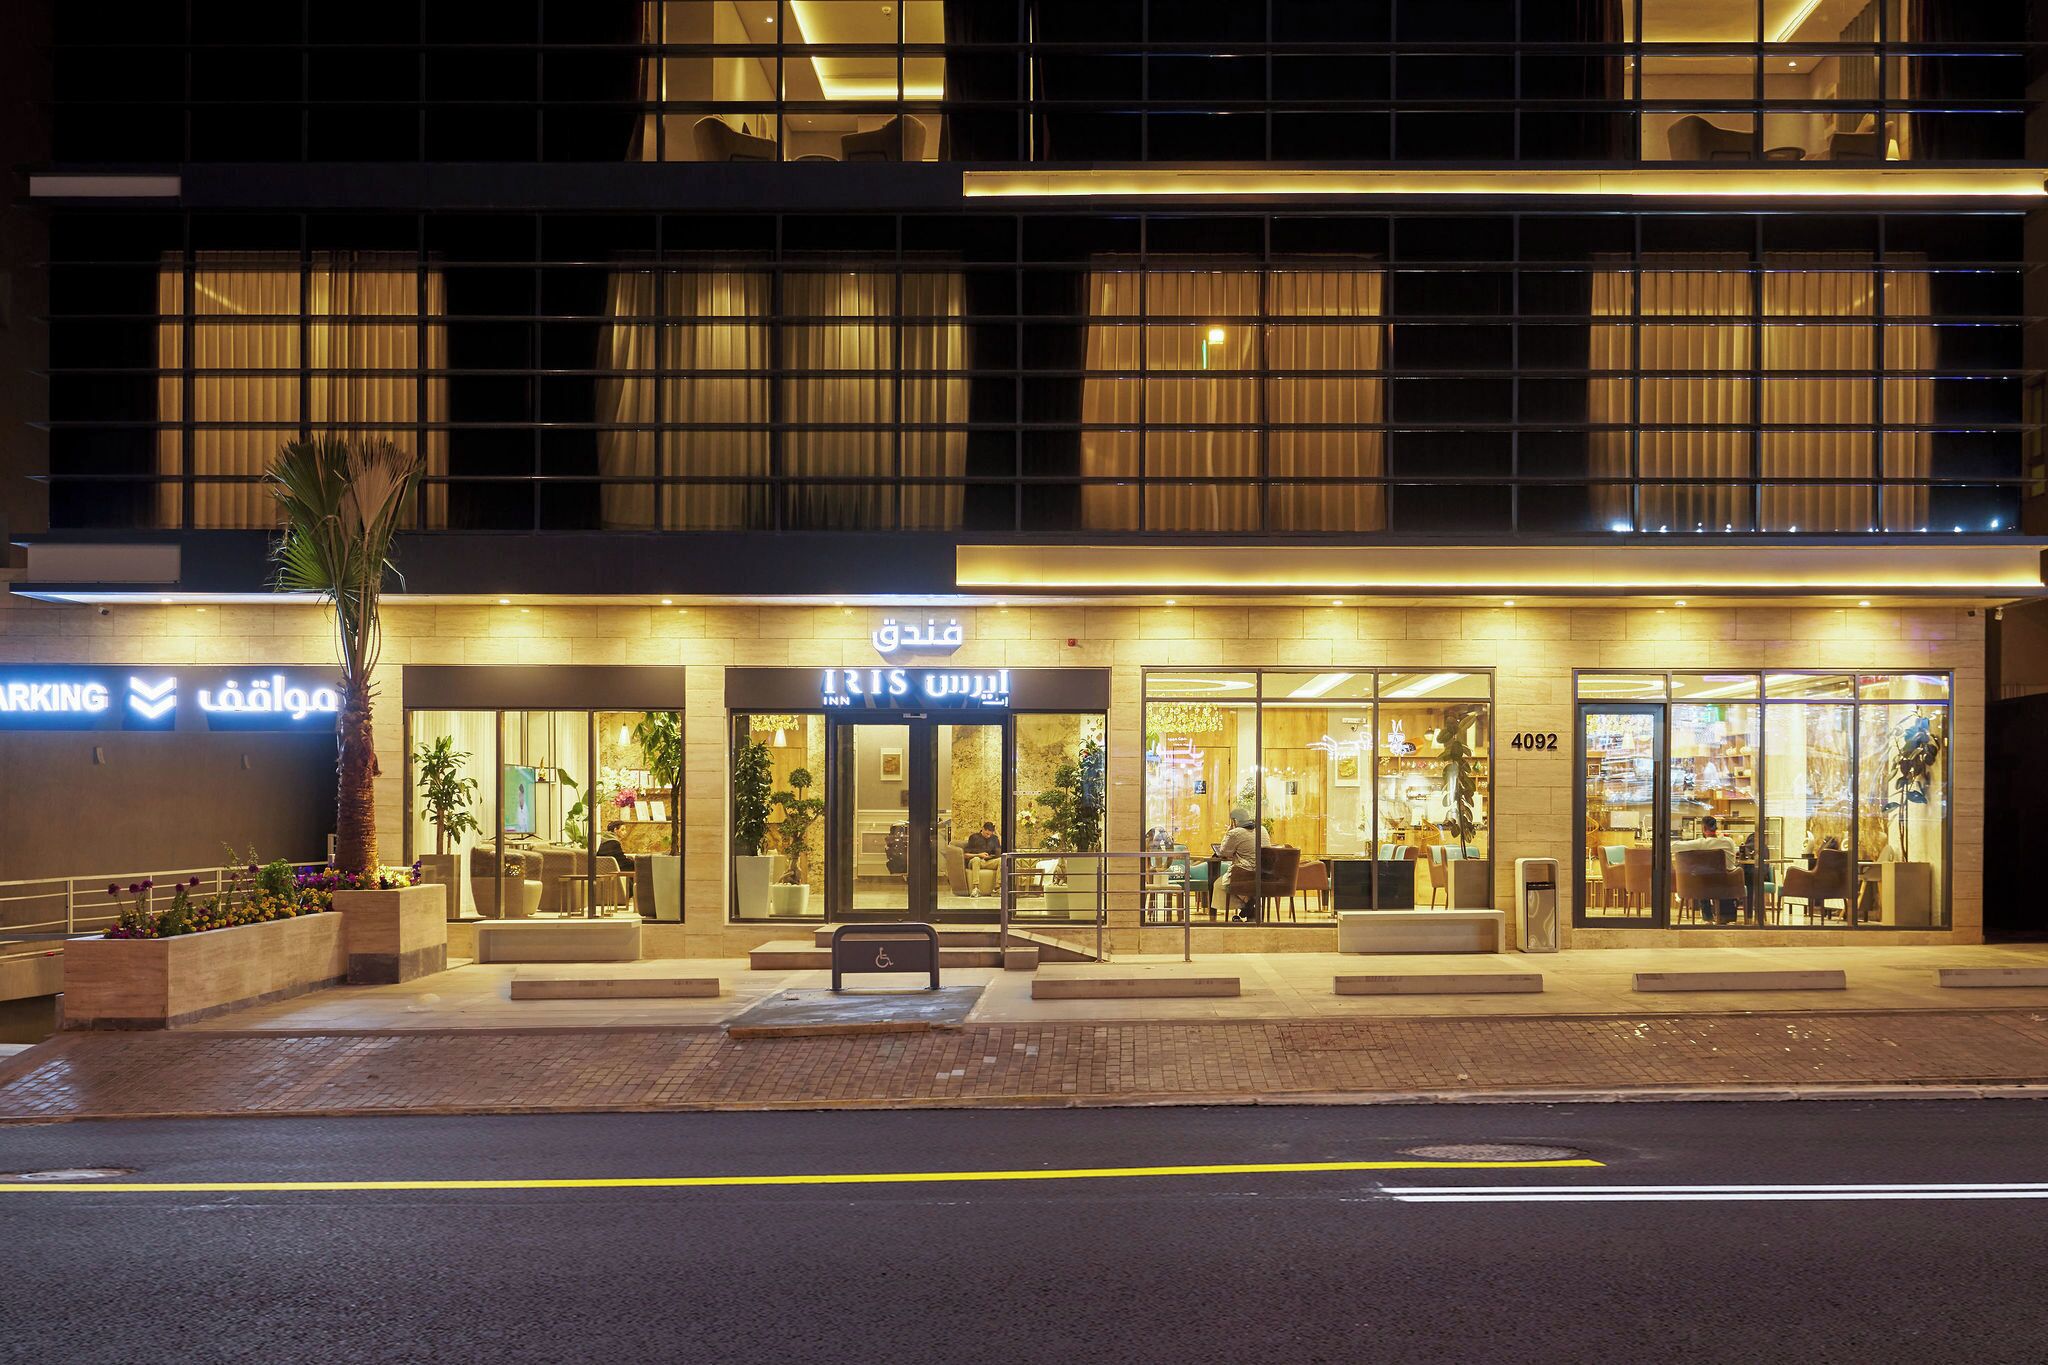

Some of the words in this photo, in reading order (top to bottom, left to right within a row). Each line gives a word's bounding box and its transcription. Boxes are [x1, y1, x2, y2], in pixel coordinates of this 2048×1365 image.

[872, 619, 962, 651] فندق
[824, 669, 907, 694] IRIS
[198, 675, 338, 719] مواقف
[823, 696, 850, 706] INN
[1511, 732, 1558, 750] 4092
